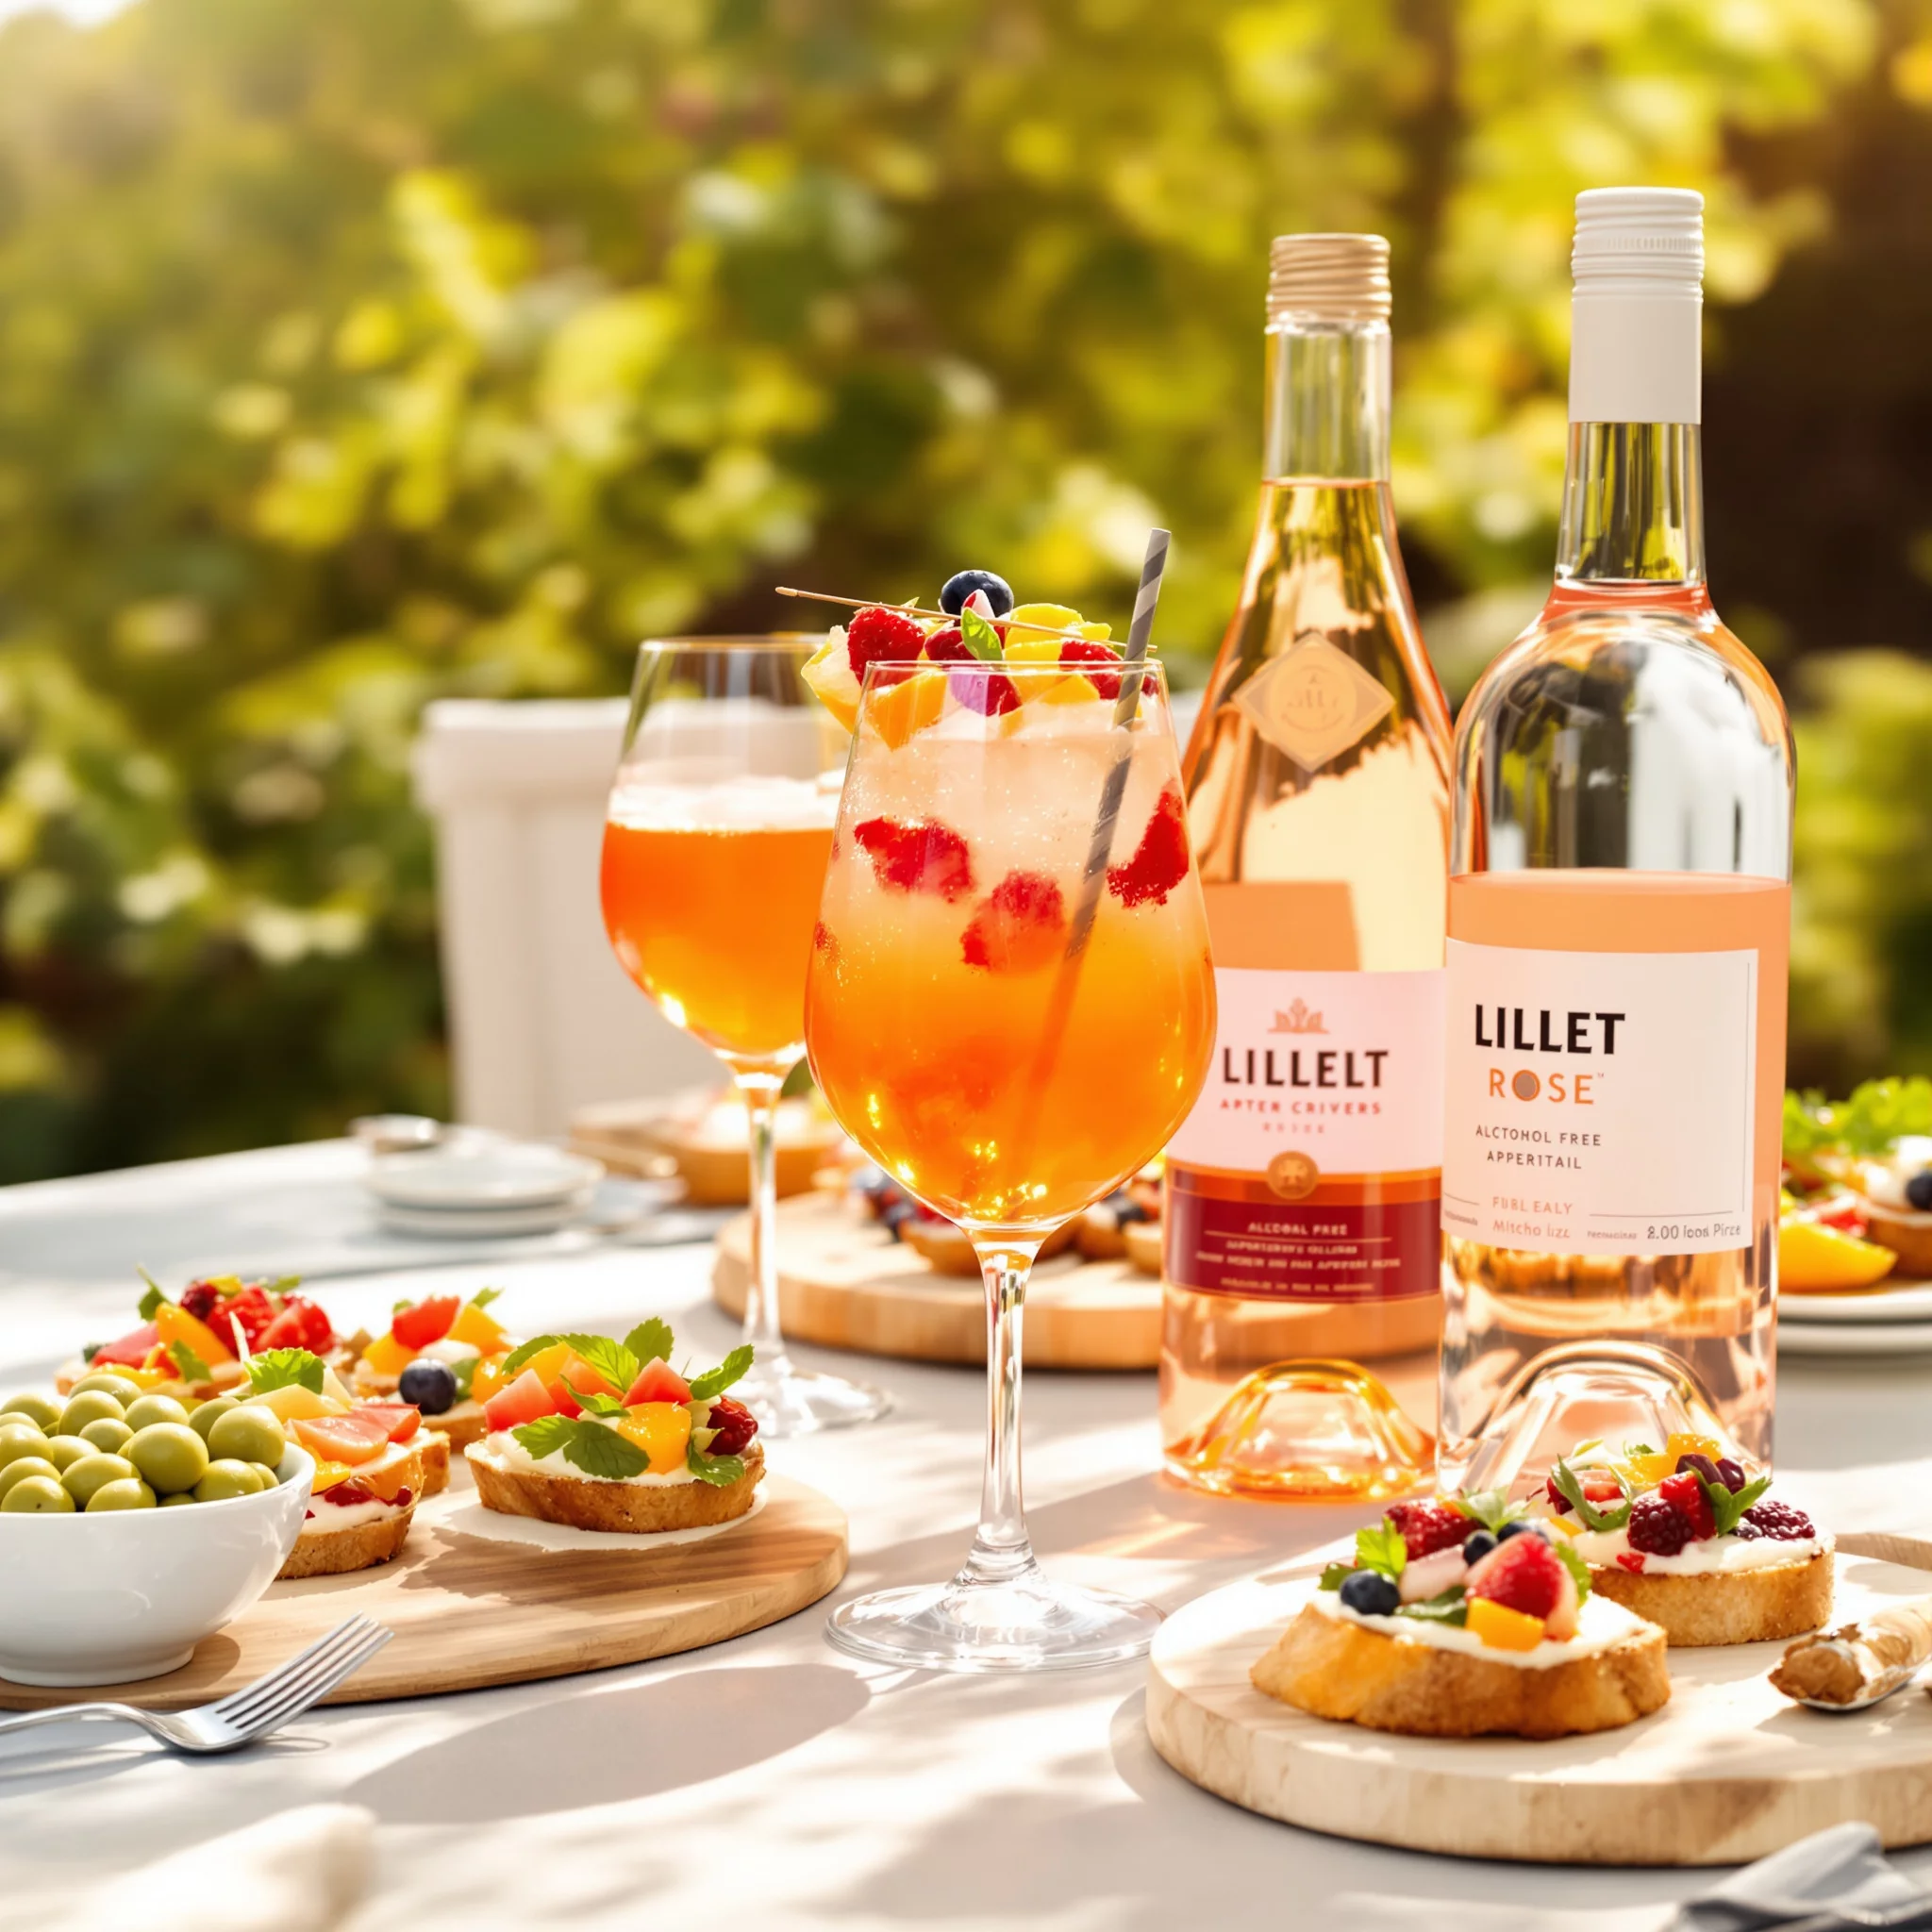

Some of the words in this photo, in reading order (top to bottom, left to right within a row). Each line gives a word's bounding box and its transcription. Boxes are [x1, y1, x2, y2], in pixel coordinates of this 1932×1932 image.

[1475, 1004, 1625, 1055] LILLET
[1223, 1047, 1390, 1089] LILLELT
[1559, 1132, 1602, 1147] FREE
[1533, 1200, 1573, 1215] EALY
